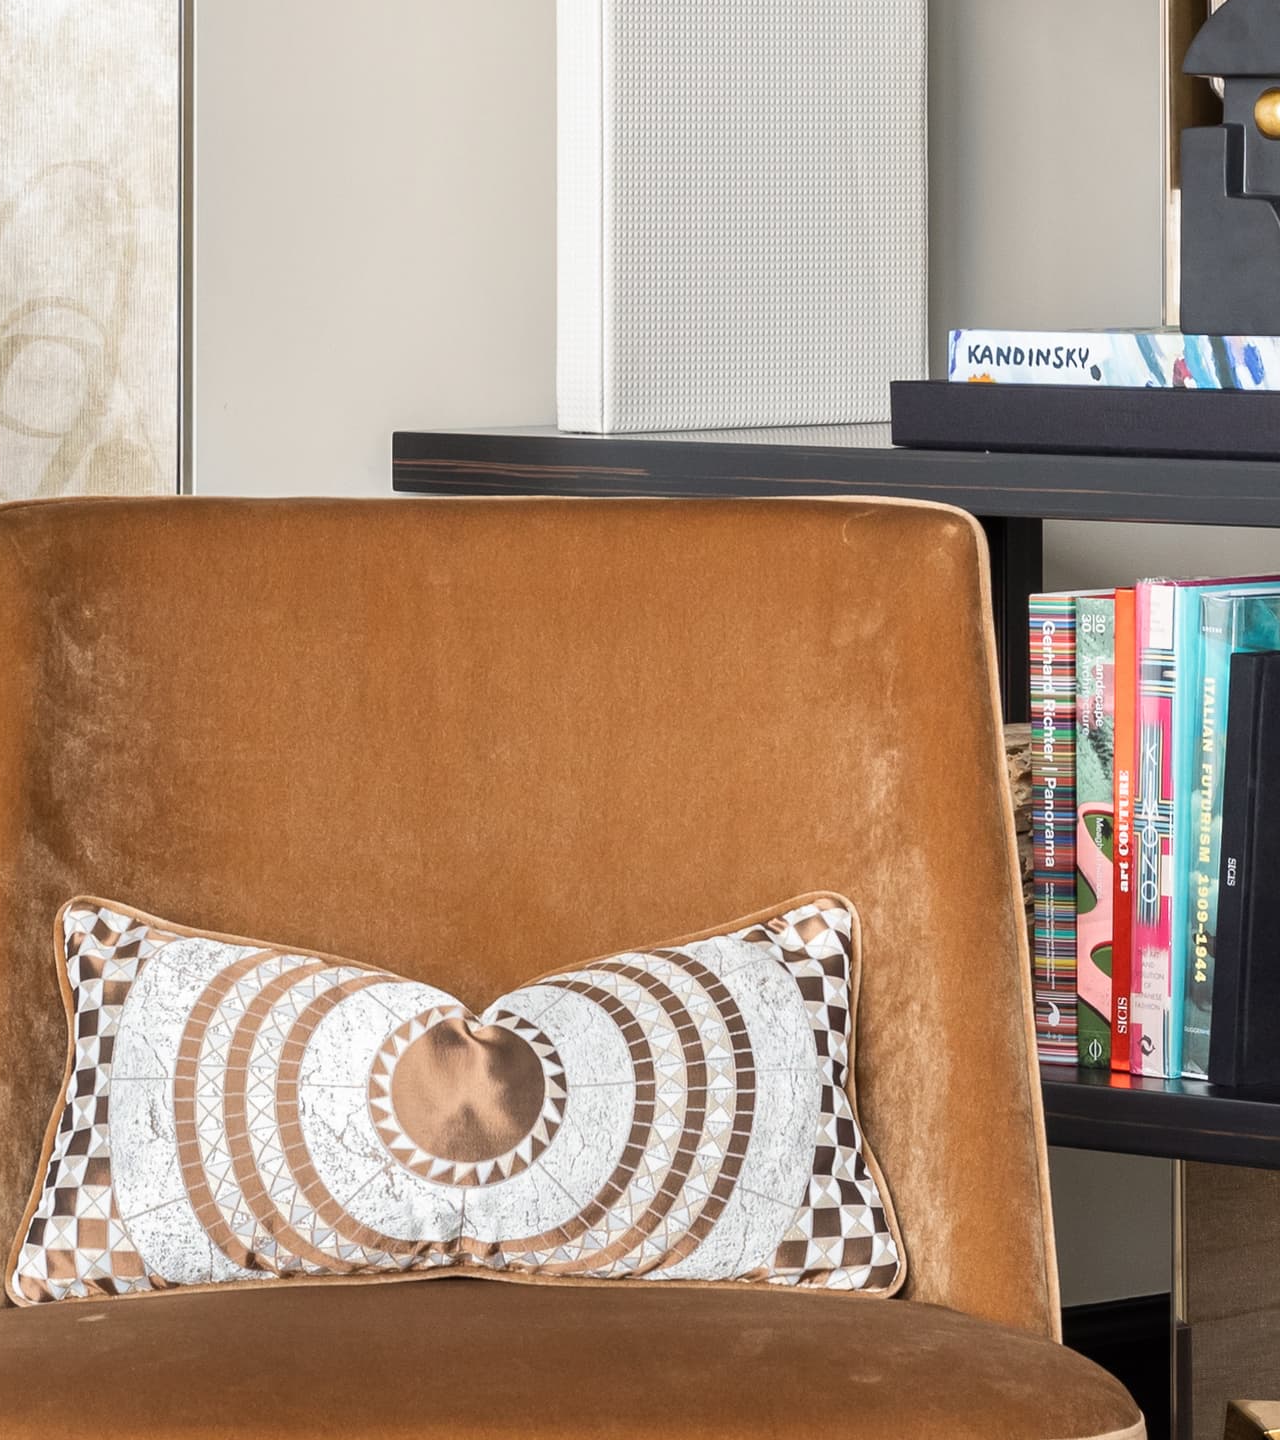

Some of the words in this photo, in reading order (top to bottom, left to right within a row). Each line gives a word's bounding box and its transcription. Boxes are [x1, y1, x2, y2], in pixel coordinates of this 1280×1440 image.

[967, 343, 1091, 369] KANDINSKY
[1081, 614, 1092, 633] 30
[1095, 614, 1106, 633] 30
[1042, 620, 1056, 695] Gerhard
[1094, 655, 1106, 727] Landscape
[1081, 655, 1092, 736] Architecture
[1201, 677, 1216, 752] ITALIAN
[1042, 699, 1057, 762] Richter
[1044, 776, 1058, 868] Panorama
[1118, 769, 1130, 857] COUTURE
[1198, 763, 1213, 863] FUTURISM
[1119, 861, 1129, 893] art
[1226, 857, 1237, 886] SICIS
[1117, 996, 1128, 1035] SICIS
